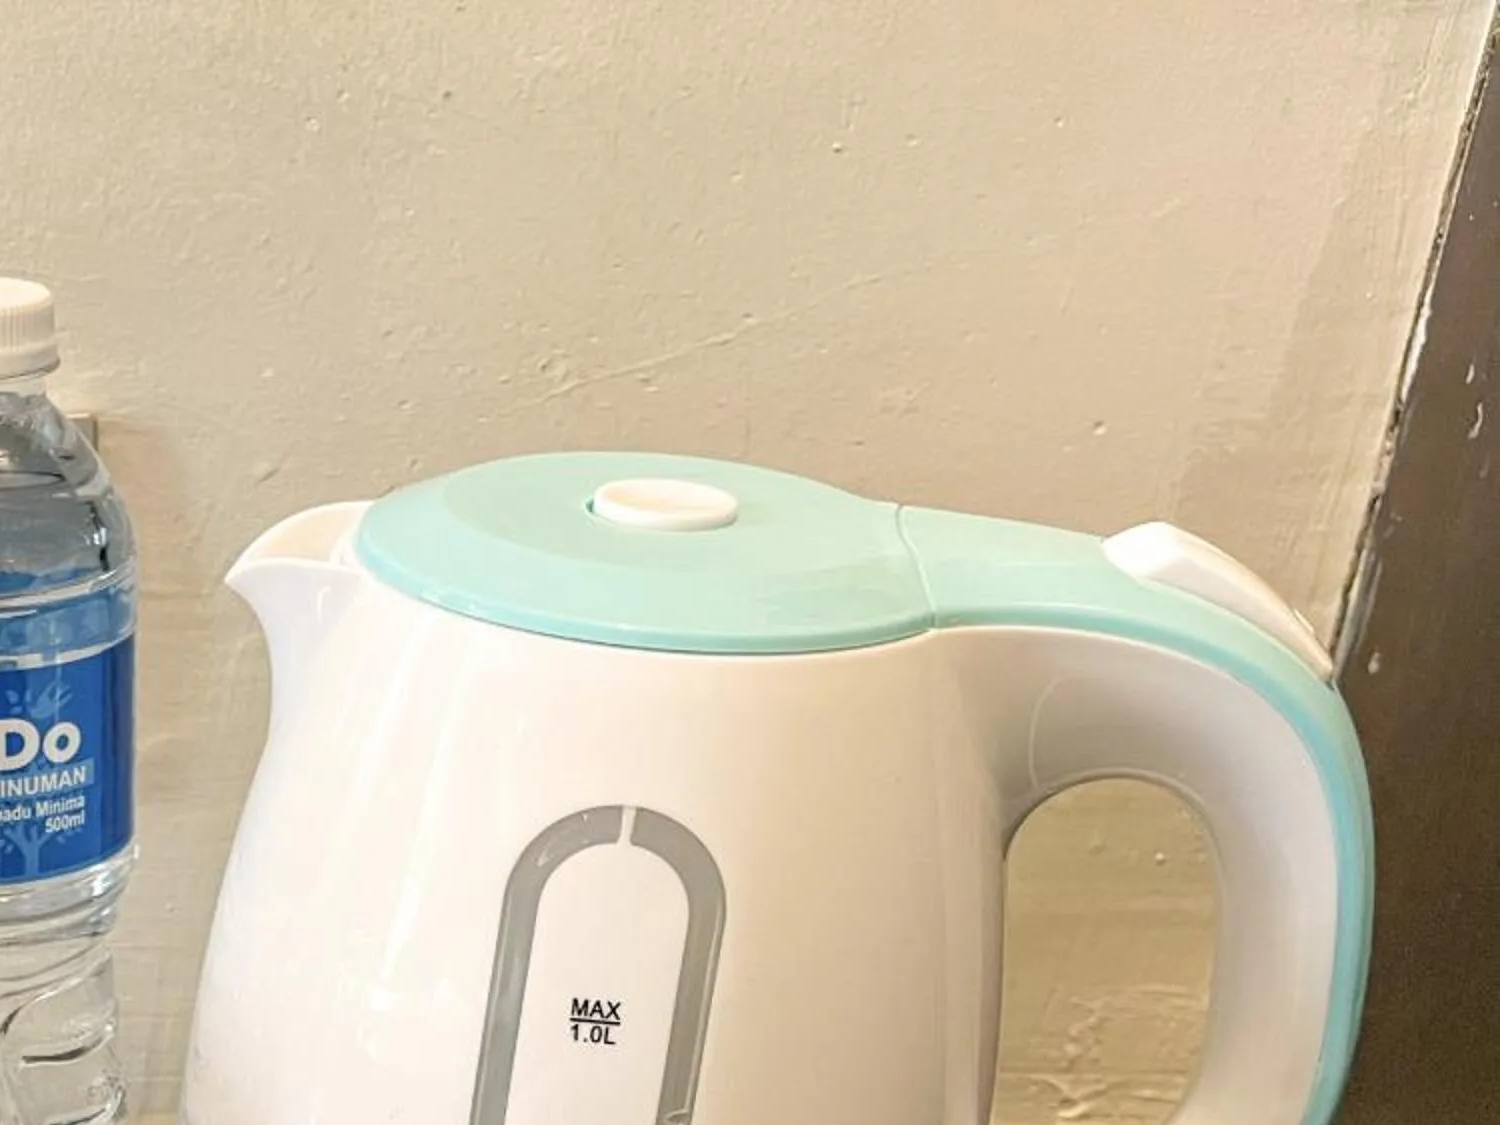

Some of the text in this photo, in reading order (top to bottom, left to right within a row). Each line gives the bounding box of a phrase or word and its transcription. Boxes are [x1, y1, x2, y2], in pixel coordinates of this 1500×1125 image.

[35, 794, 86, 817] Minima
[45, 813, 86, 834] 500ml
[571, 998, 621, 1020] MAX
[570, 1025, 617, 1046] 1.0L
